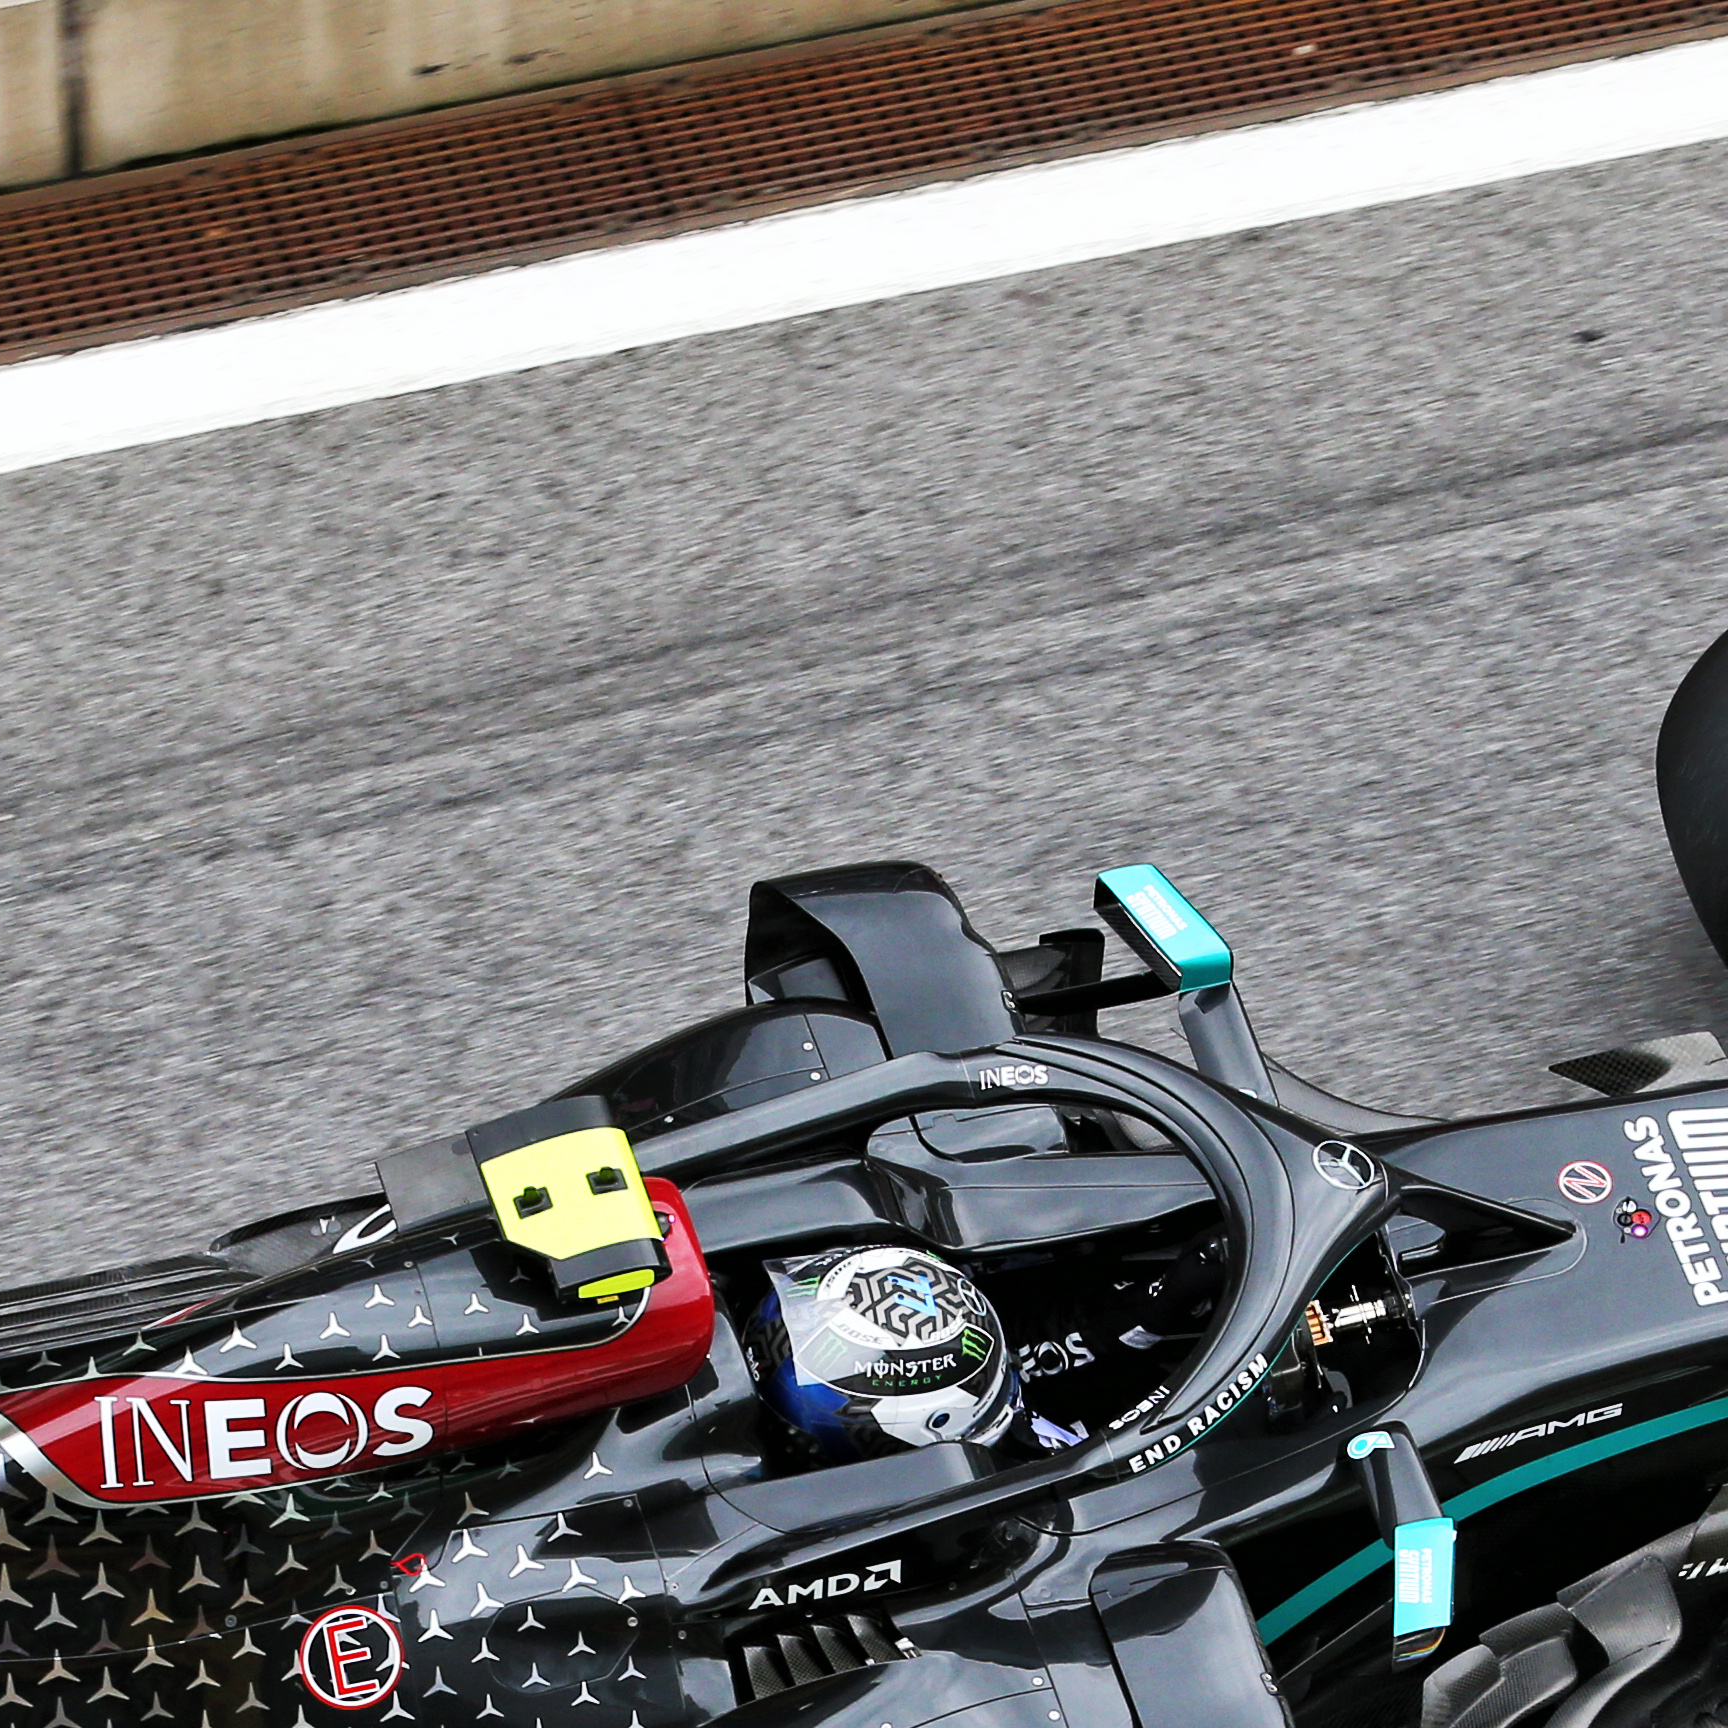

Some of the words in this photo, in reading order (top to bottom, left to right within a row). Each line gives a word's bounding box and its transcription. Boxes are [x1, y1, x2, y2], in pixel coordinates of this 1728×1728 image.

[1126, 891, 1178, 940] SYNTIUM
[1143, 884, 1188, 931] PETRONAS
[978, 1064, 1049, 1091] INEOS
[872, 1374, 942, 1387] ENERGY
[1108, 1385, 1171, 1430] INEOS
[1129, 1434, 1182, 1474] END
[1187, 1352, 1269, 1437] RACISM
[1504, 1403, 1624, 1448] AMG
[93, 1386, 435, 1490] INEOS
[748, 1567, 865, 1610] AMD
[1398, 1549, 1420, 1604] SYNTIUM
[1421, 1548, 1433, 1604] PETRONAS
